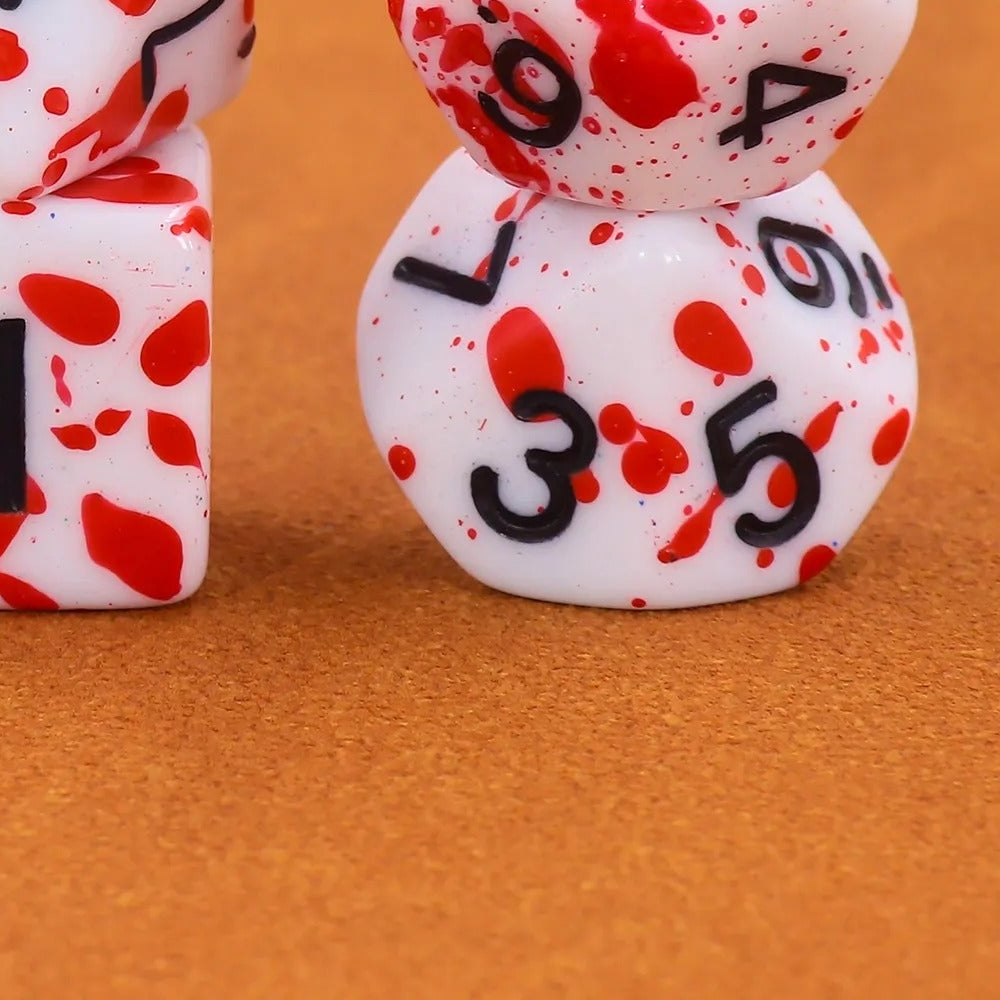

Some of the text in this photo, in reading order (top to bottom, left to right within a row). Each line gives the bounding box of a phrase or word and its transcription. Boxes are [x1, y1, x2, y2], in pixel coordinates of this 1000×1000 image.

[717, 62, 849, 152] 4
[392, 220, 518, 307] 7
[469, 387, 600, 546] 3
[704, 378, 822, 549] 5
